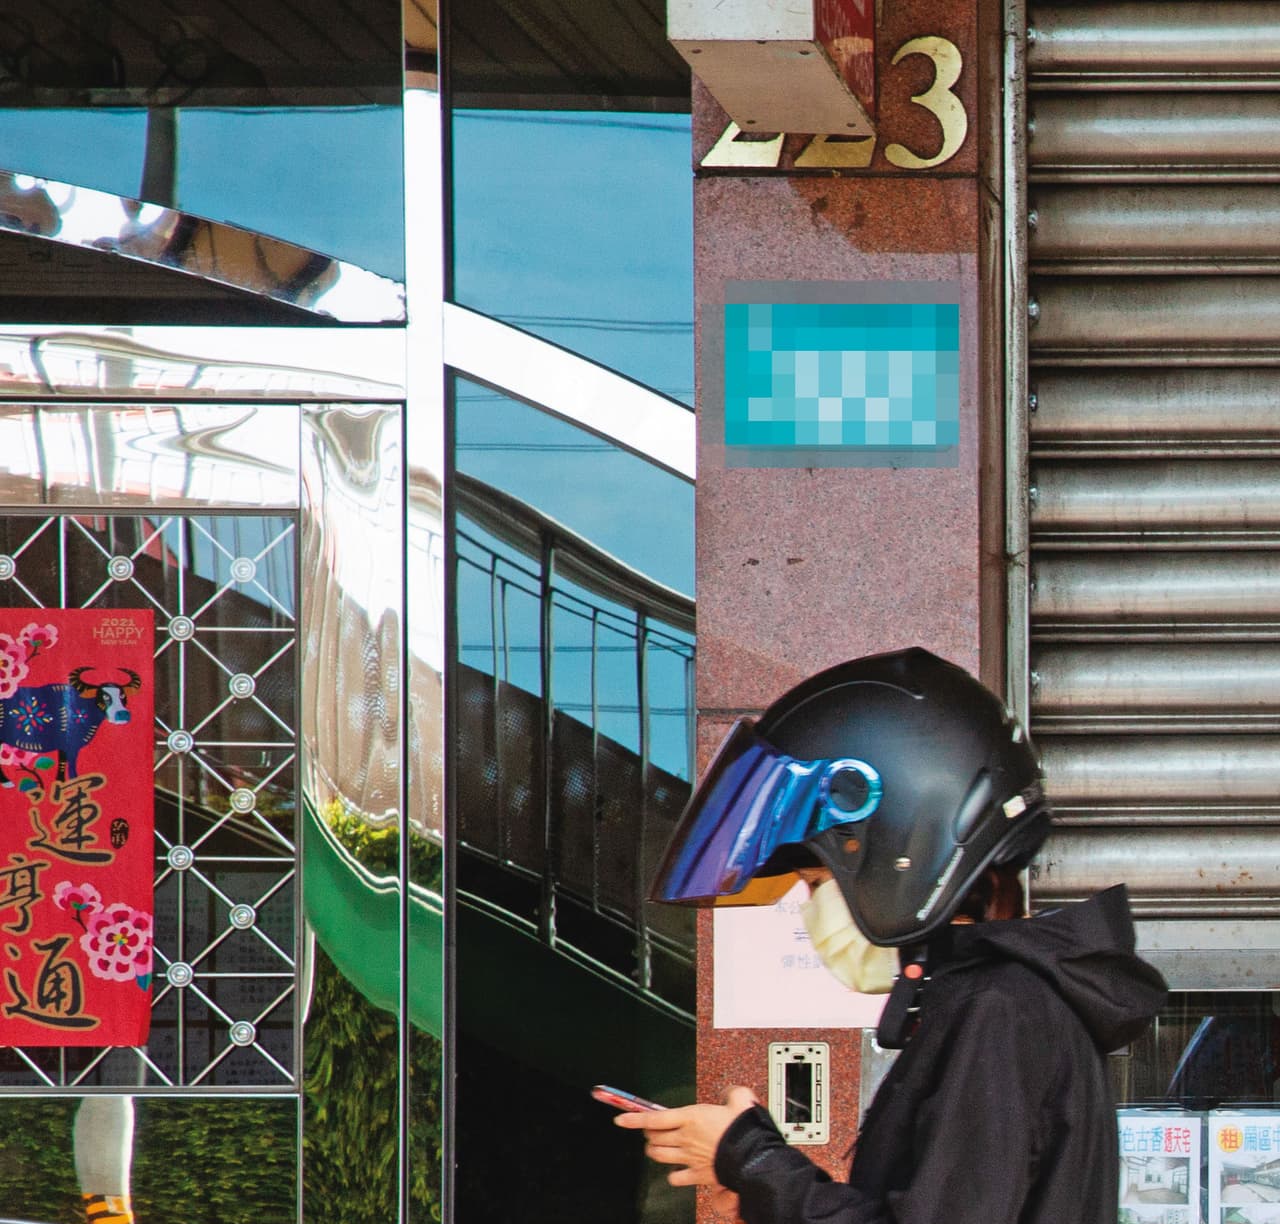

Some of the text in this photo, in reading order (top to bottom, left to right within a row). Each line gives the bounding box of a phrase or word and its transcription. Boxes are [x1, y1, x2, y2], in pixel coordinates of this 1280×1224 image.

[101, 617, 136, 627] 2021
[93, 626, 145, 640] HAPPY
[1118, 1125, 1191, 1153] 色古香透天宅
